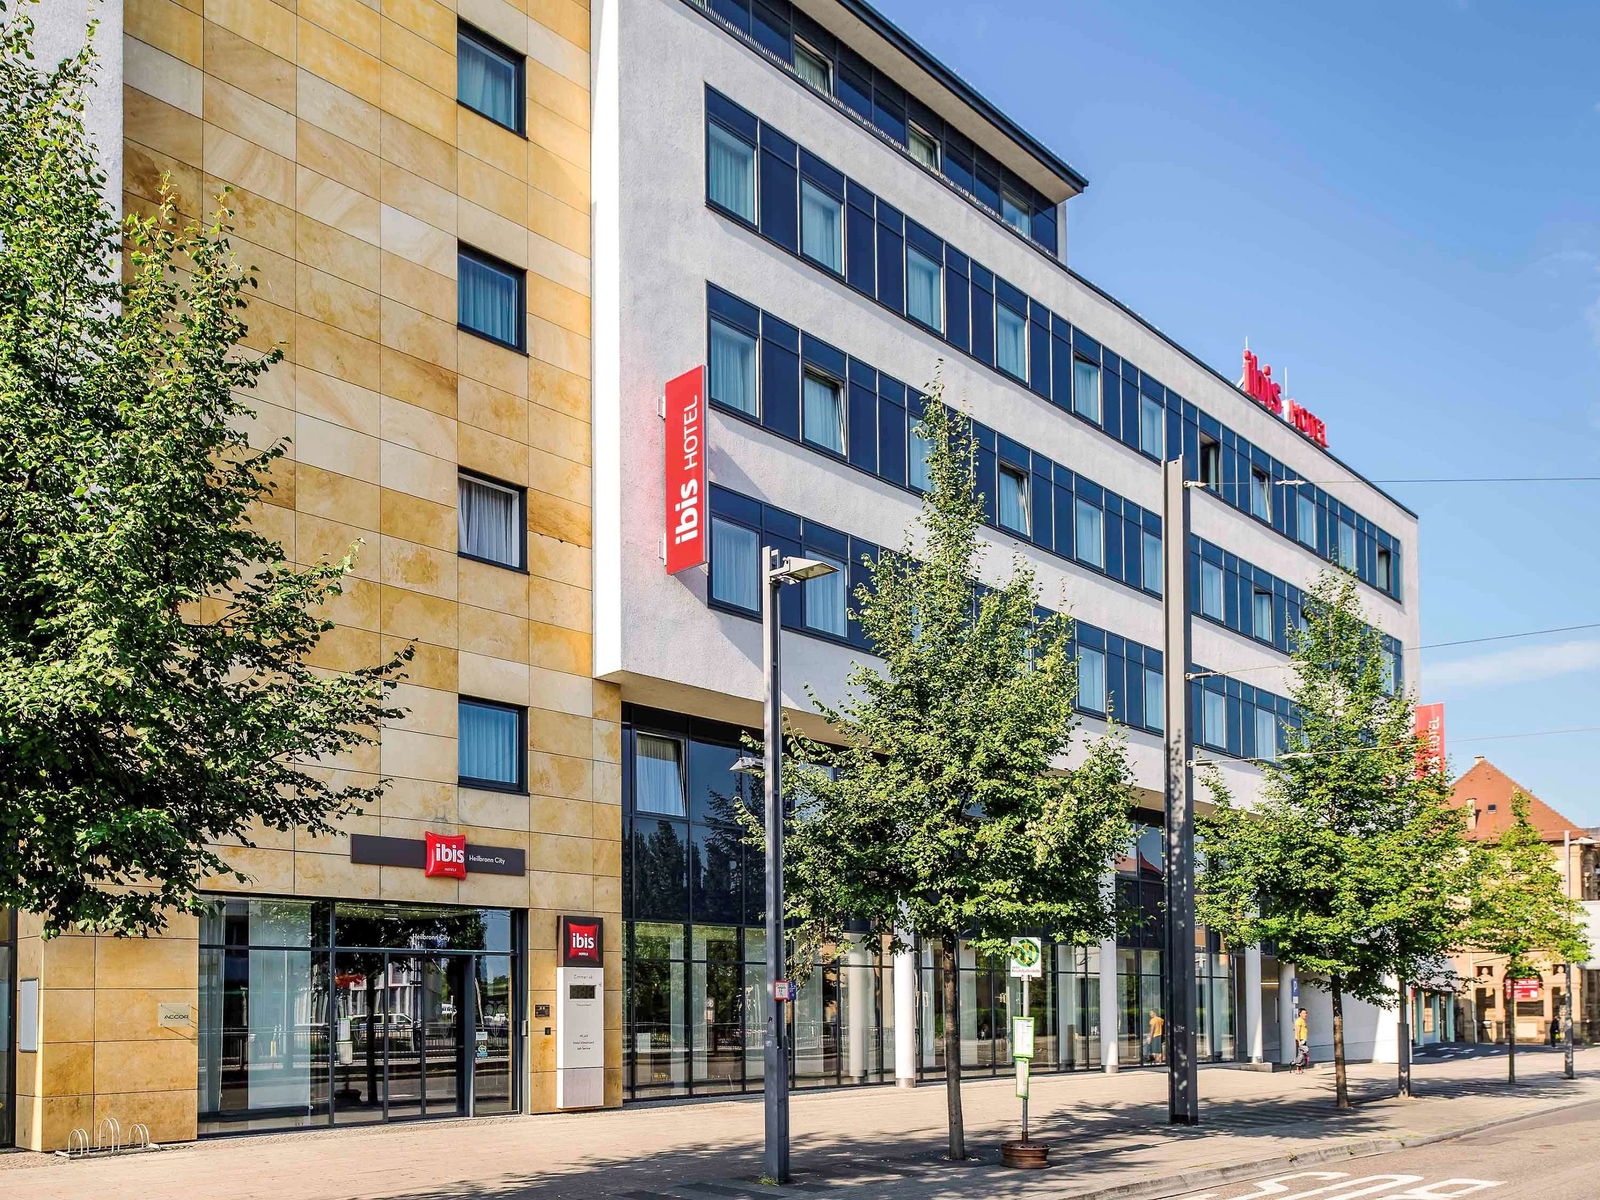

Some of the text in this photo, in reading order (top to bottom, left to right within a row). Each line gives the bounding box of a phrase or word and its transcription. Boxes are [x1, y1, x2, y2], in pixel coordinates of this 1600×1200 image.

[1243, 350, 1330, 448] ibis HOTEL
[675, 395, 698, 544] ibis HOTEL
[435, 843, 464, 864] ibis
[494, 856, 506, 865] City
[572, 932, 595, 949] ibis
